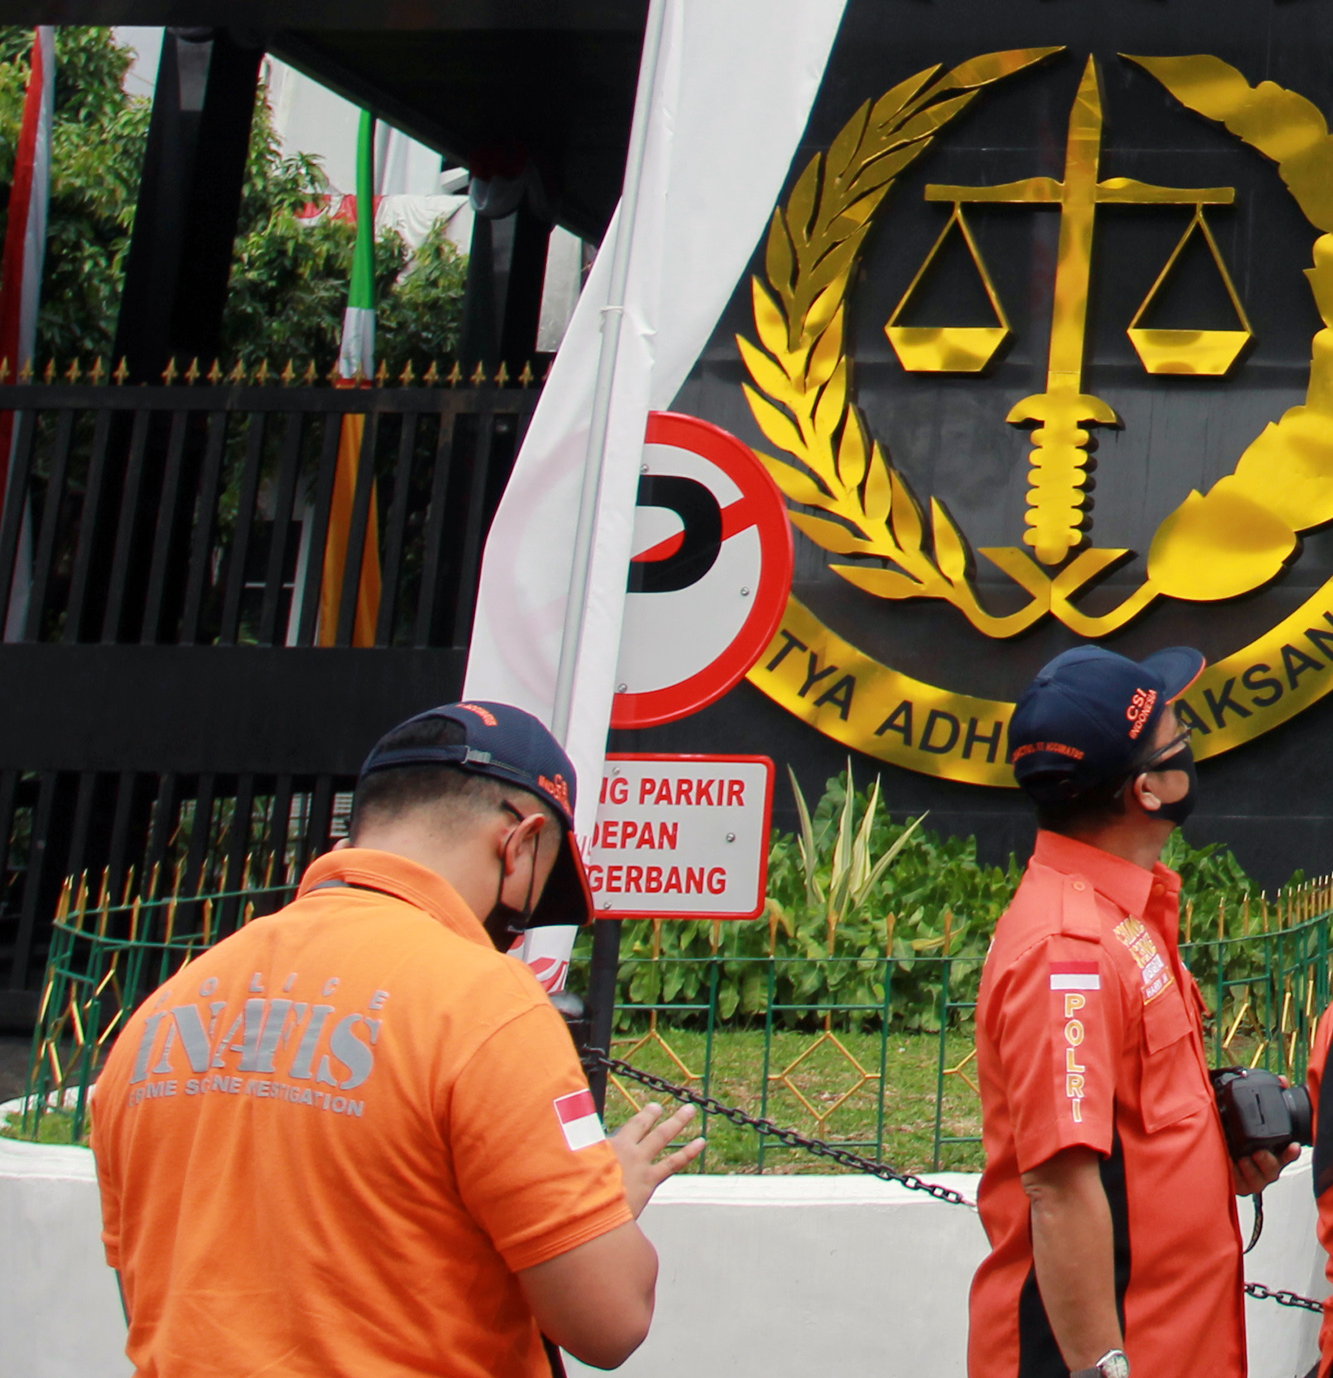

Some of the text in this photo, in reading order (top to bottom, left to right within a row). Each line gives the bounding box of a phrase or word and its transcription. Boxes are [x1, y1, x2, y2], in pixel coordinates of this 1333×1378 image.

[765, 628, 857, 722] TYA
[873, 699, 1013, 765] ADH
[1125, 687, 1148, 722] CSI
[1128, 688, 1158, 740] INDONESIA
[639, 777, 745, 807] PARKIR
[586, 864, 727, 895] GERBANG
[1063, 993, 1087, 1123] POLRI
